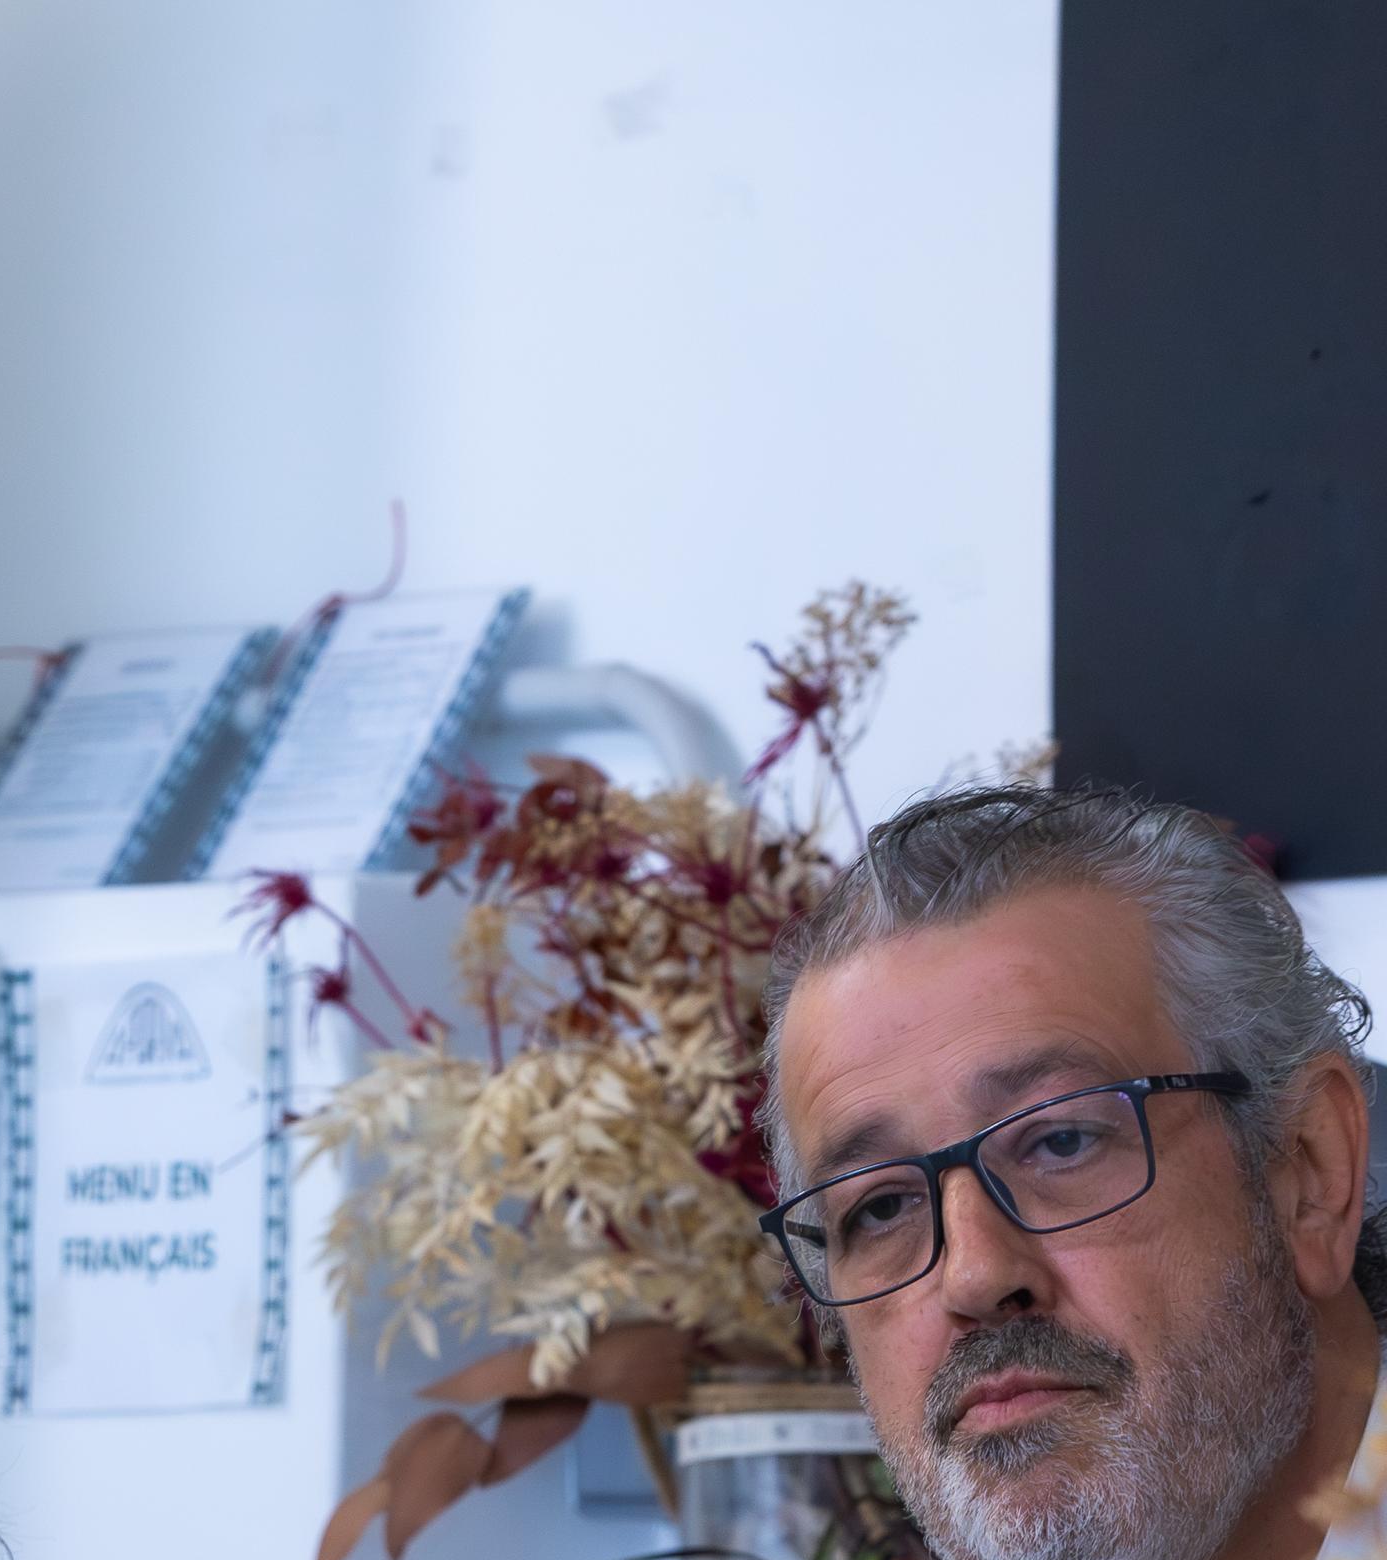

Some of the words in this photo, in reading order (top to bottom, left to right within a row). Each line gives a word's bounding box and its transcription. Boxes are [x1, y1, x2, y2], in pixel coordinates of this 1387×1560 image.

[67, 1163, 157, 1202] MENU
[168, 1161, 212, 1200] EN
[61, 1231, 216, 1284] FRANÇAIS
